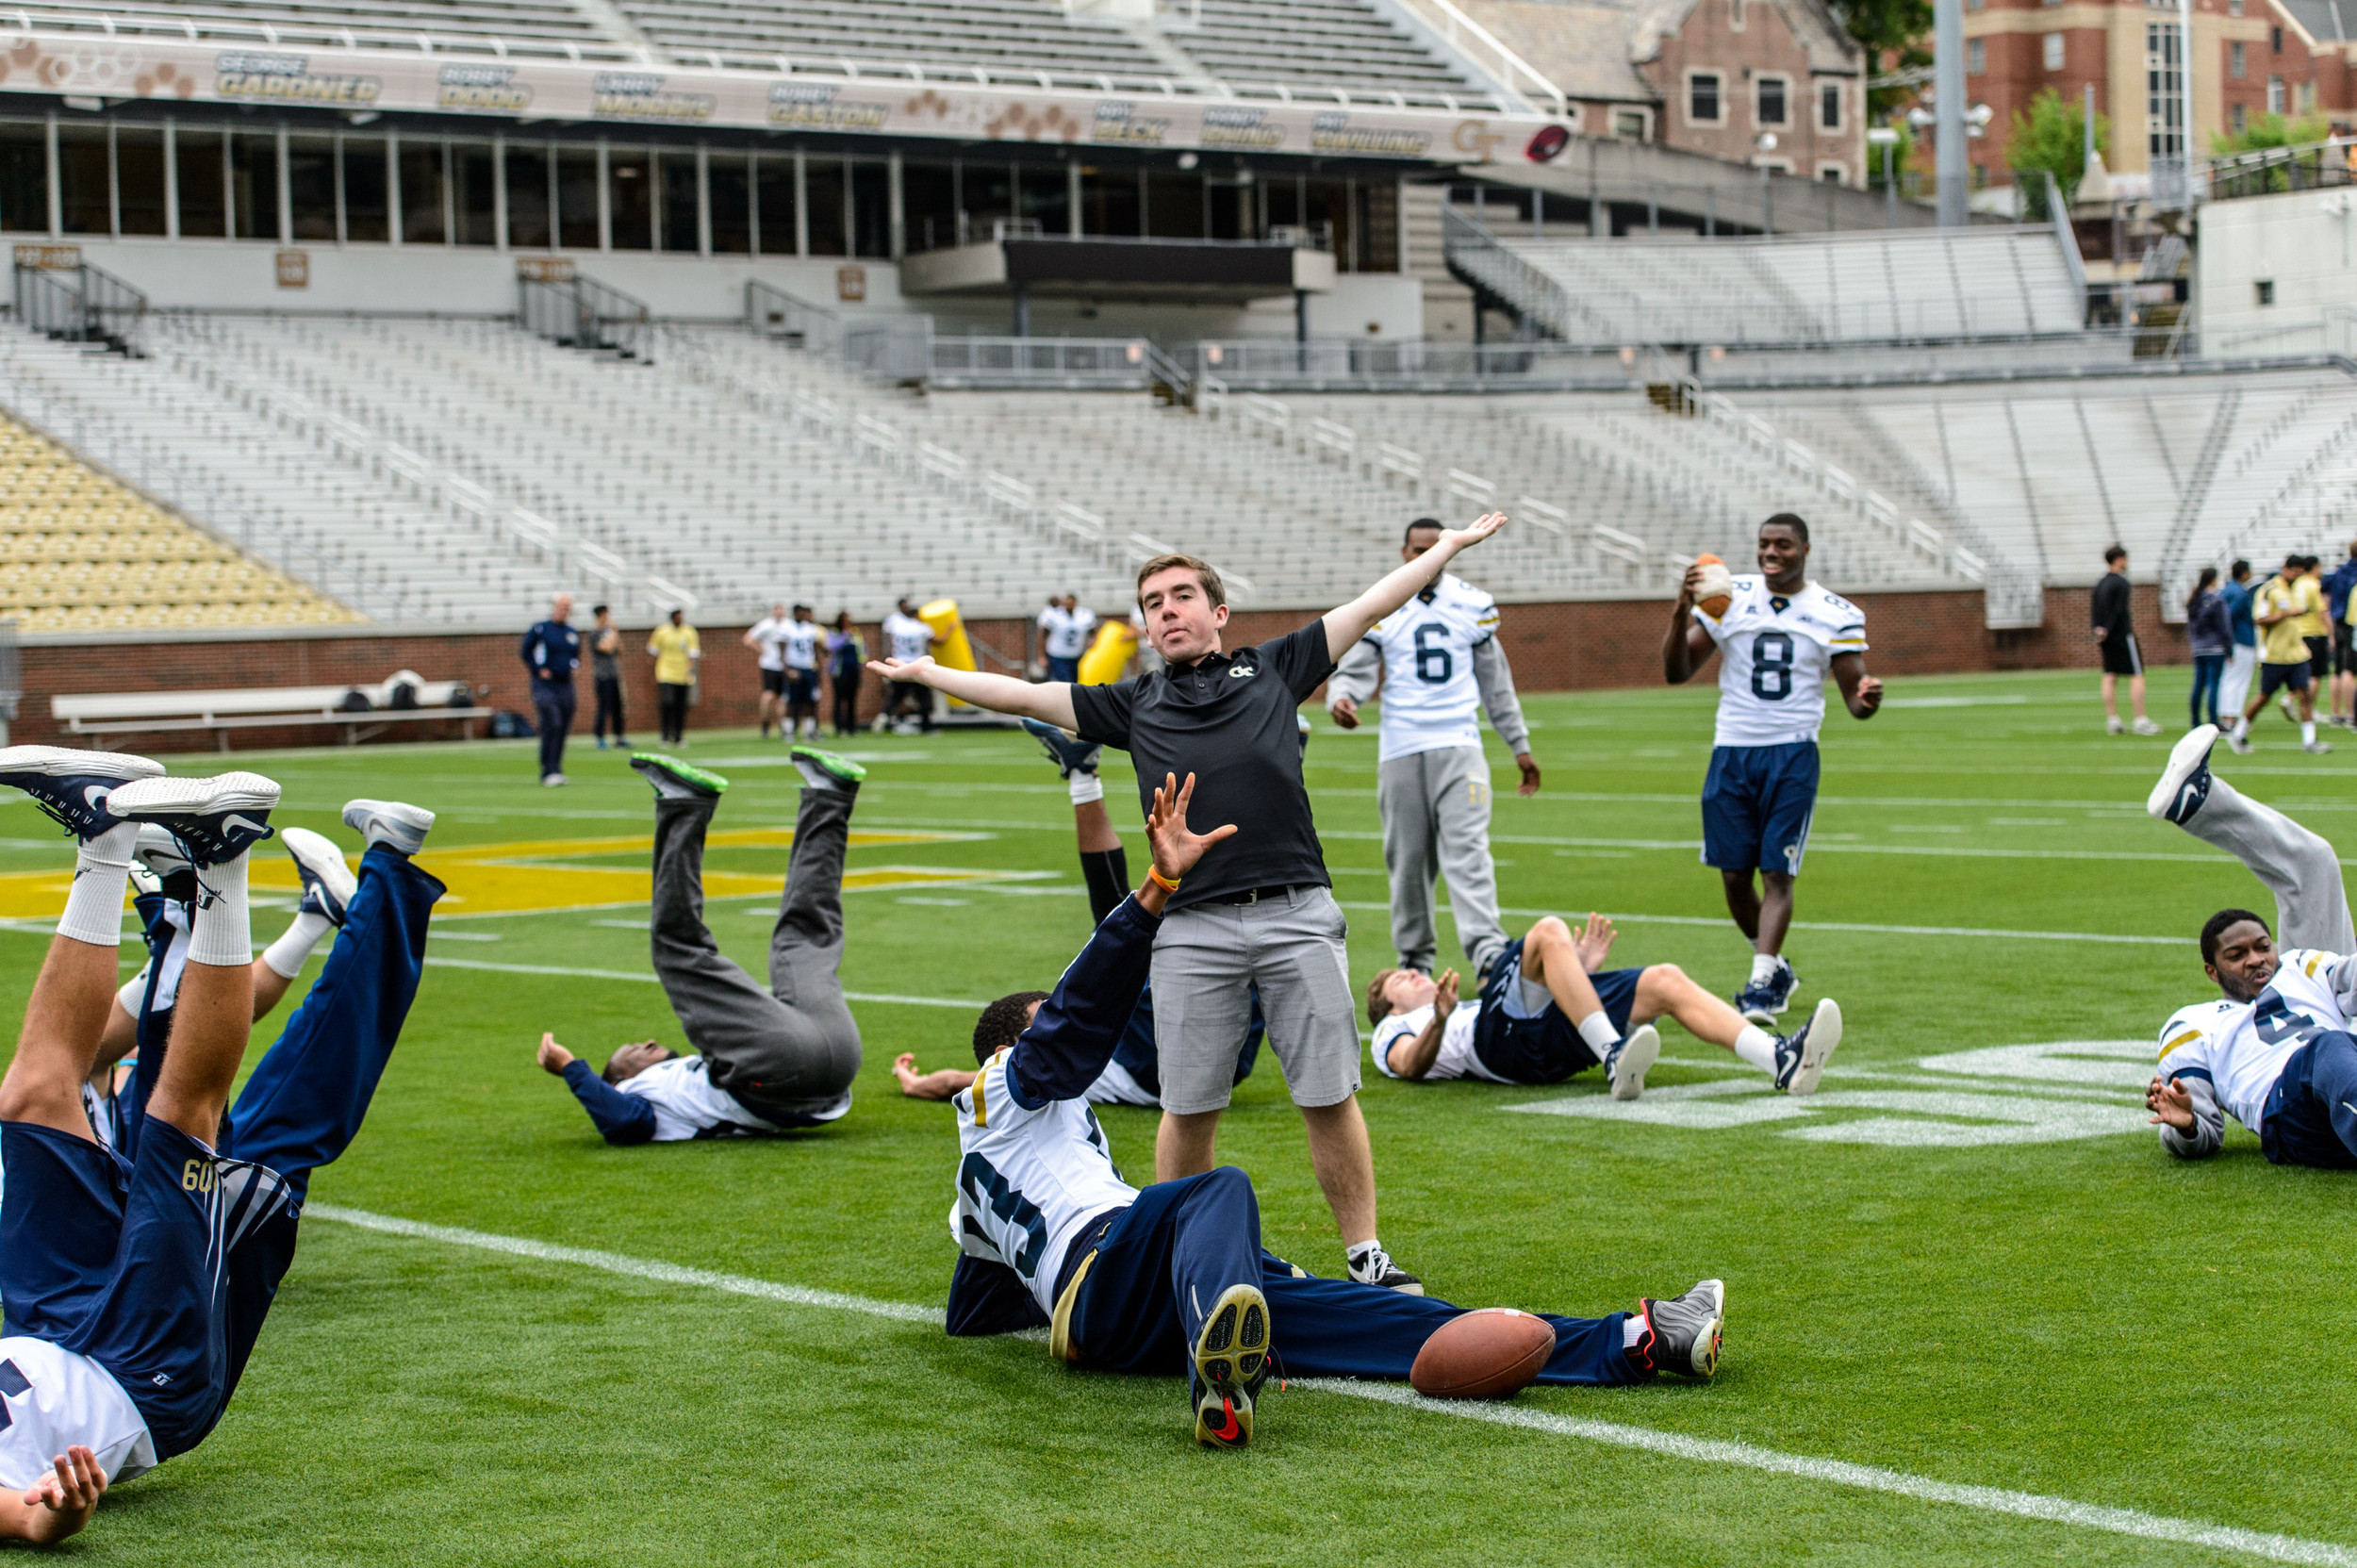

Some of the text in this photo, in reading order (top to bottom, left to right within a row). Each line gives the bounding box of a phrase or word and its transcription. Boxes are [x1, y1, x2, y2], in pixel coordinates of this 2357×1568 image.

[219, 55, 307, 75] GEORGE
[218, 74, 378, 103] GARDNER
[440, 85, 529, 109] DODD
[594, 93, 714, 119] MORRIS
[770, 102, 884, 126] GASTON
[1094, 118, 1165, 140] BECK
[1415, 623, 1451, 683] 6
[1752, 633, 1793, 700] 8
